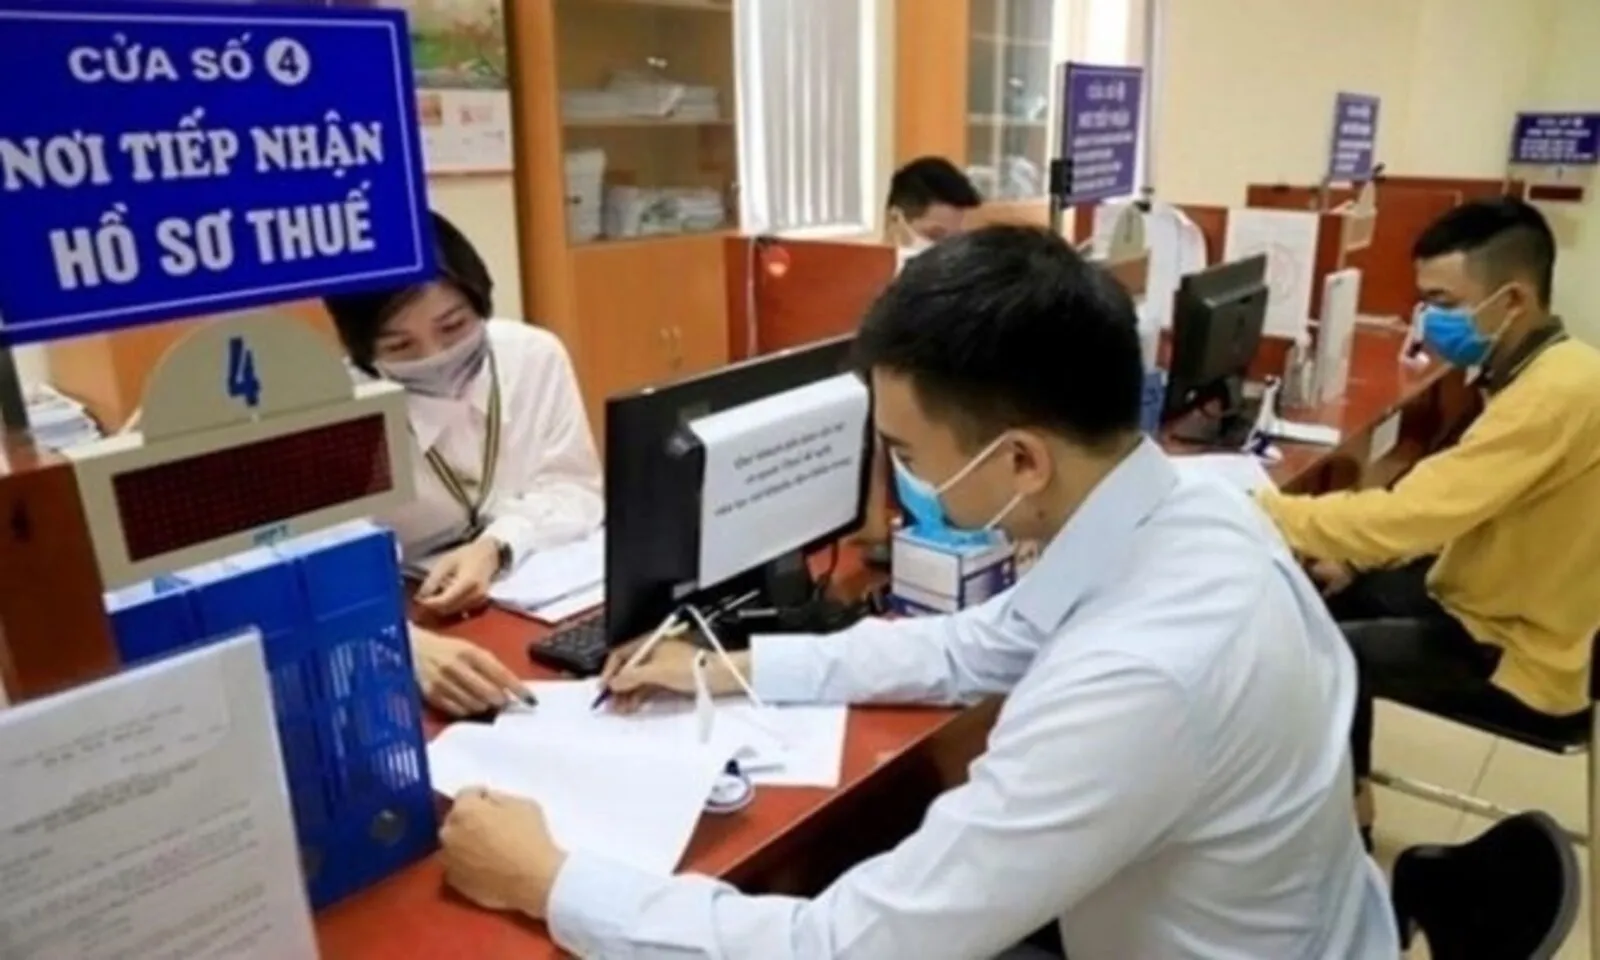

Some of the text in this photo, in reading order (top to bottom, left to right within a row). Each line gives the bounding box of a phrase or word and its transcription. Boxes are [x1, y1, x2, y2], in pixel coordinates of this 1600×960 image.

[70, 35, 177, 81] CỬA
[192, 34, 251, 79] SỐ
[0, 108, 382, 189] NƠI TIẾP NHẬN
[51, 182, 374, 288] HỒ SƠ THUẾ
[228, 337, 261, 407] 4
